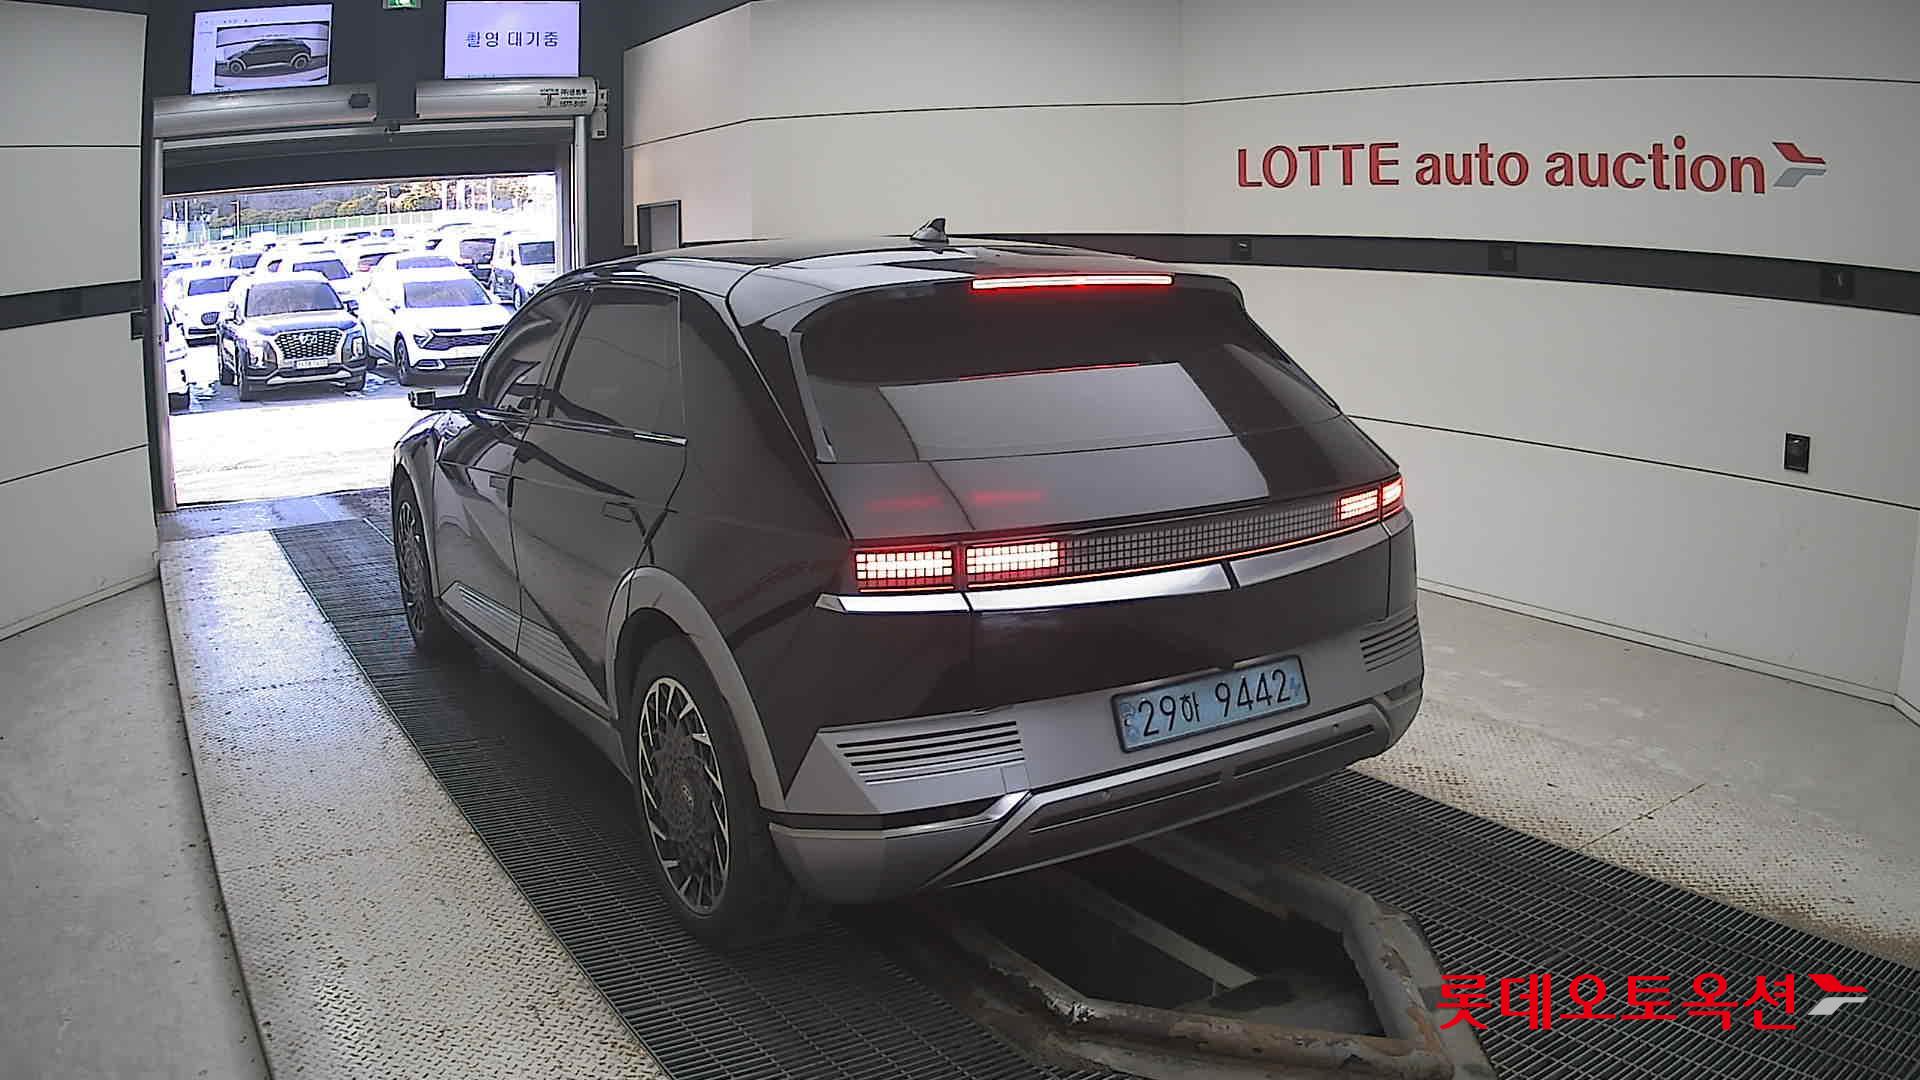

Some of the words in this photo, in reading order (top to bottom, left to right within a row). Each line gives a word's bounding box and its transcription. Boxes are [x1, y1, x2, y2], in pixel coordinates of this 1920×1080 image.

[507, 31, 558, 47] 대기중
[1237, 142, 1400, 188] LOTTE
[1415, 142, 1529, 187] auto
[1544, 135, 1766, 195] auction
[1138, 691, 1201, 737] 29하
[1215, 669, 1291, 718] 9442
